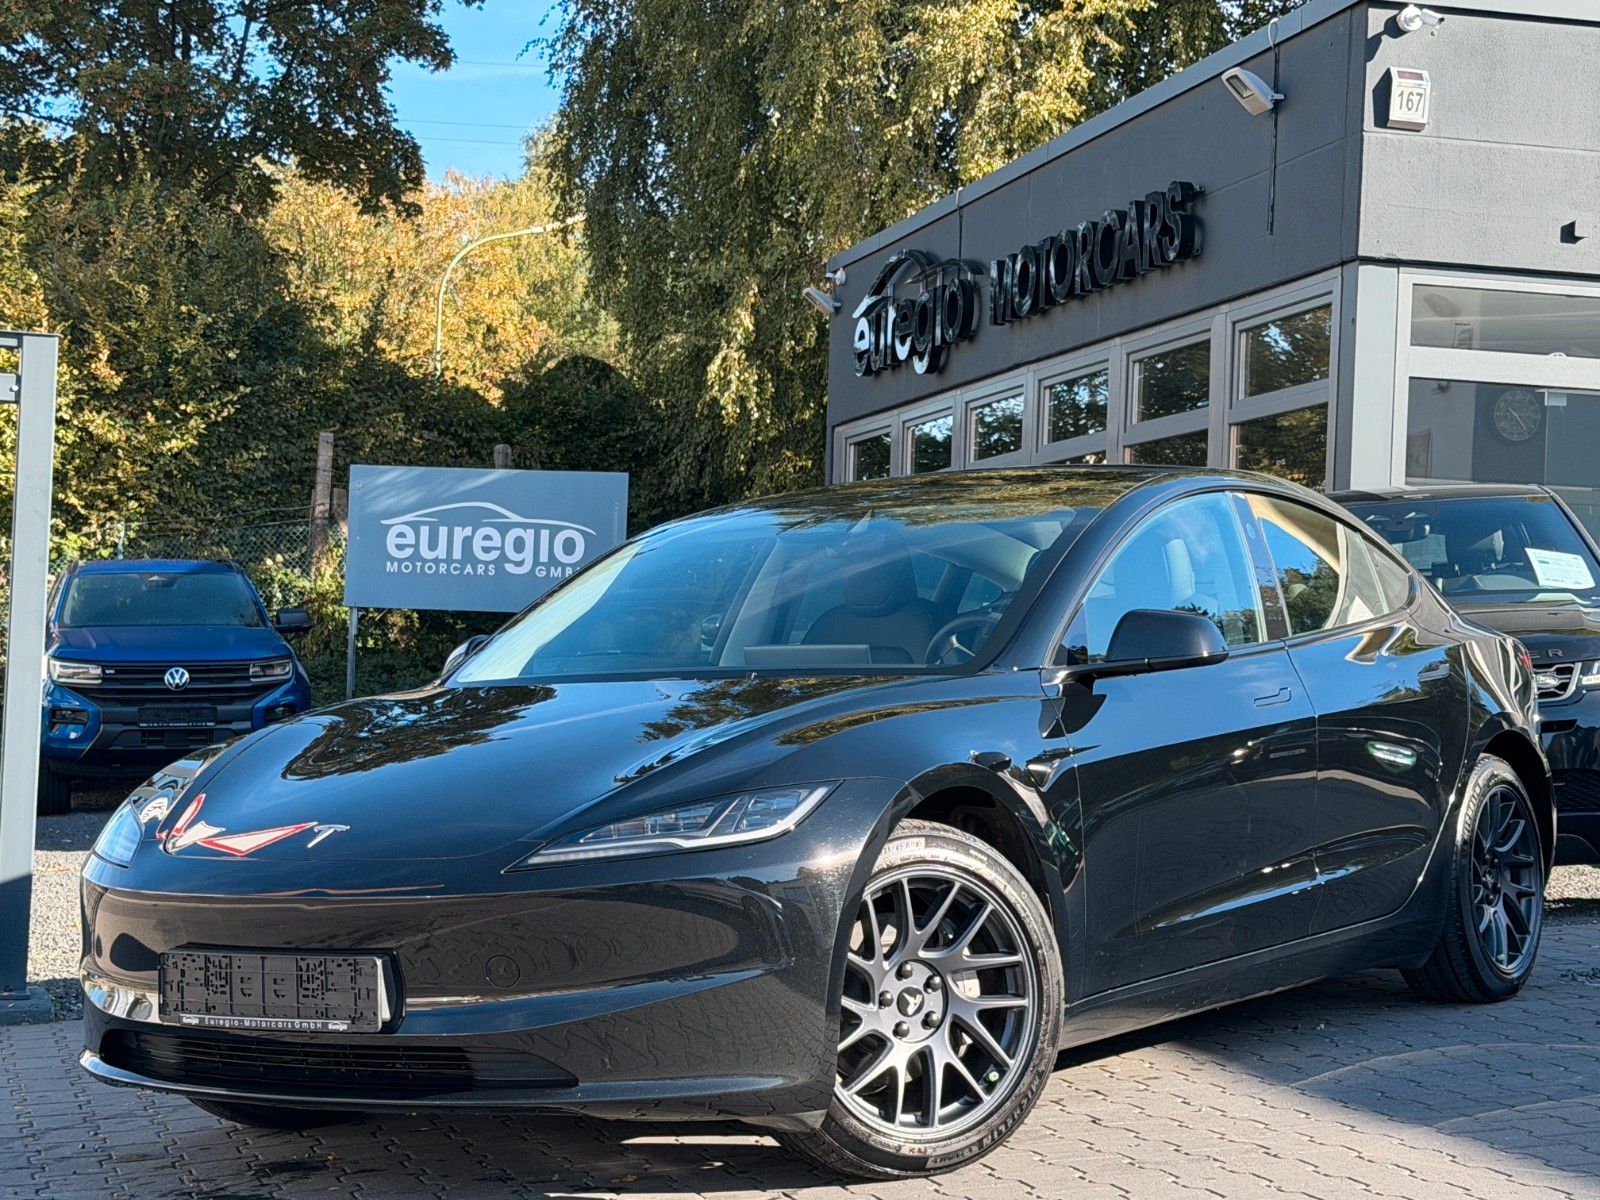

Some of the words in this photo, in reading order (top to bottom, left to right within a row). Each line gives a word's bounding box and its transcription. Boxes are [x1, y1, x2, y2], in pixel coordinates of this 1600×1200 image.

[1397, 89, 1424, 113] 167
[990, 181, 1195, 326] MOTORCARS
[386, 524, 586, 575] euregio
[386, 560, 496, 576] MOTORCARS
[535, 565, 580, 578] GMB
